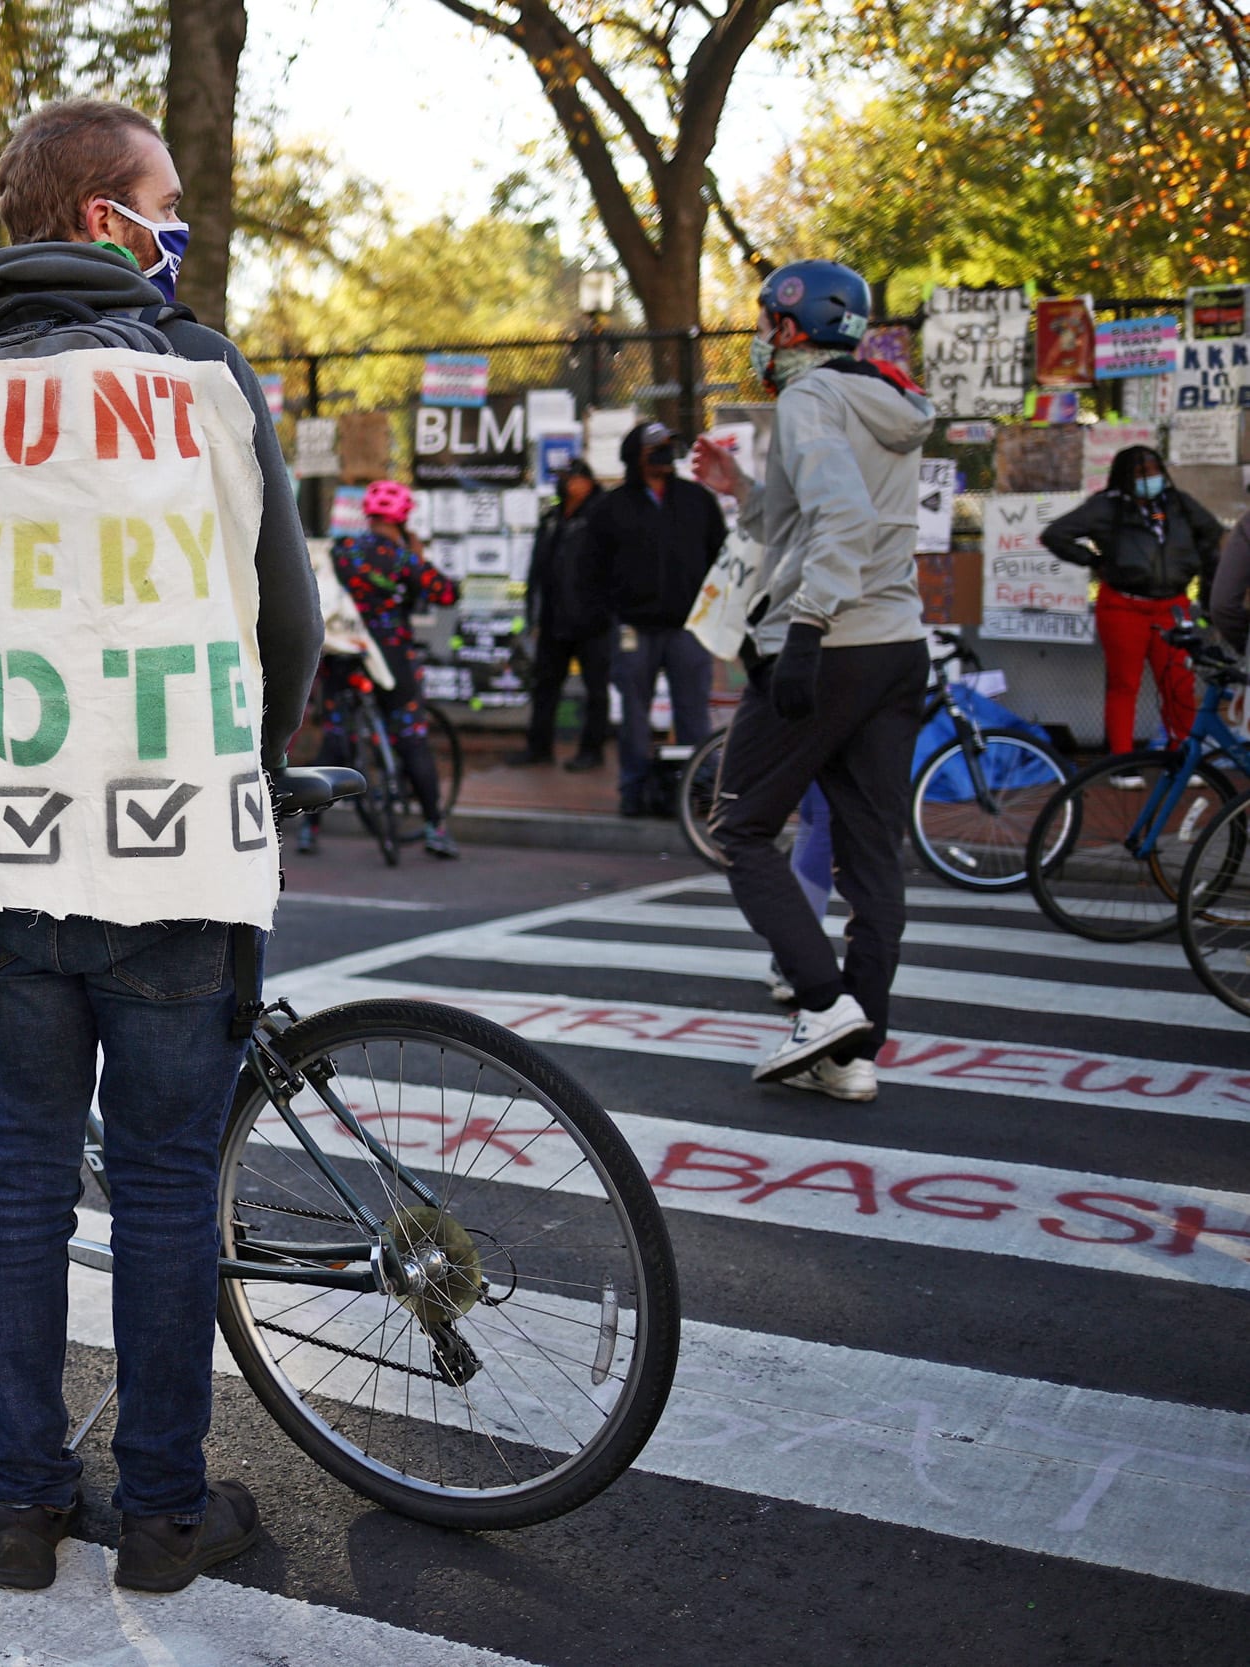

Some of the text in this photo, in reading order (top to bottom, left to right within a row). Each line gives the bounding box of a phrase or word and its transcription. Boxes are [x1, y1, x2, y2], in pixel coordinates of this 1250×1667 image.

[1111, 324, 1161, 336] BLACK
[1112, 336, 1162, 347] TRANS
[1106, 358, 1168, 371] MATTER
[1115, 348, 1159, 359] LIVES
[980, 364, 1023, 390] ALL
[1177, 384, 1250, 410] BLUE
[415, 404, 526, 455] BLM
[999, 502, 1054, 525] WE
[996, 582, 1086, 608] Reform
